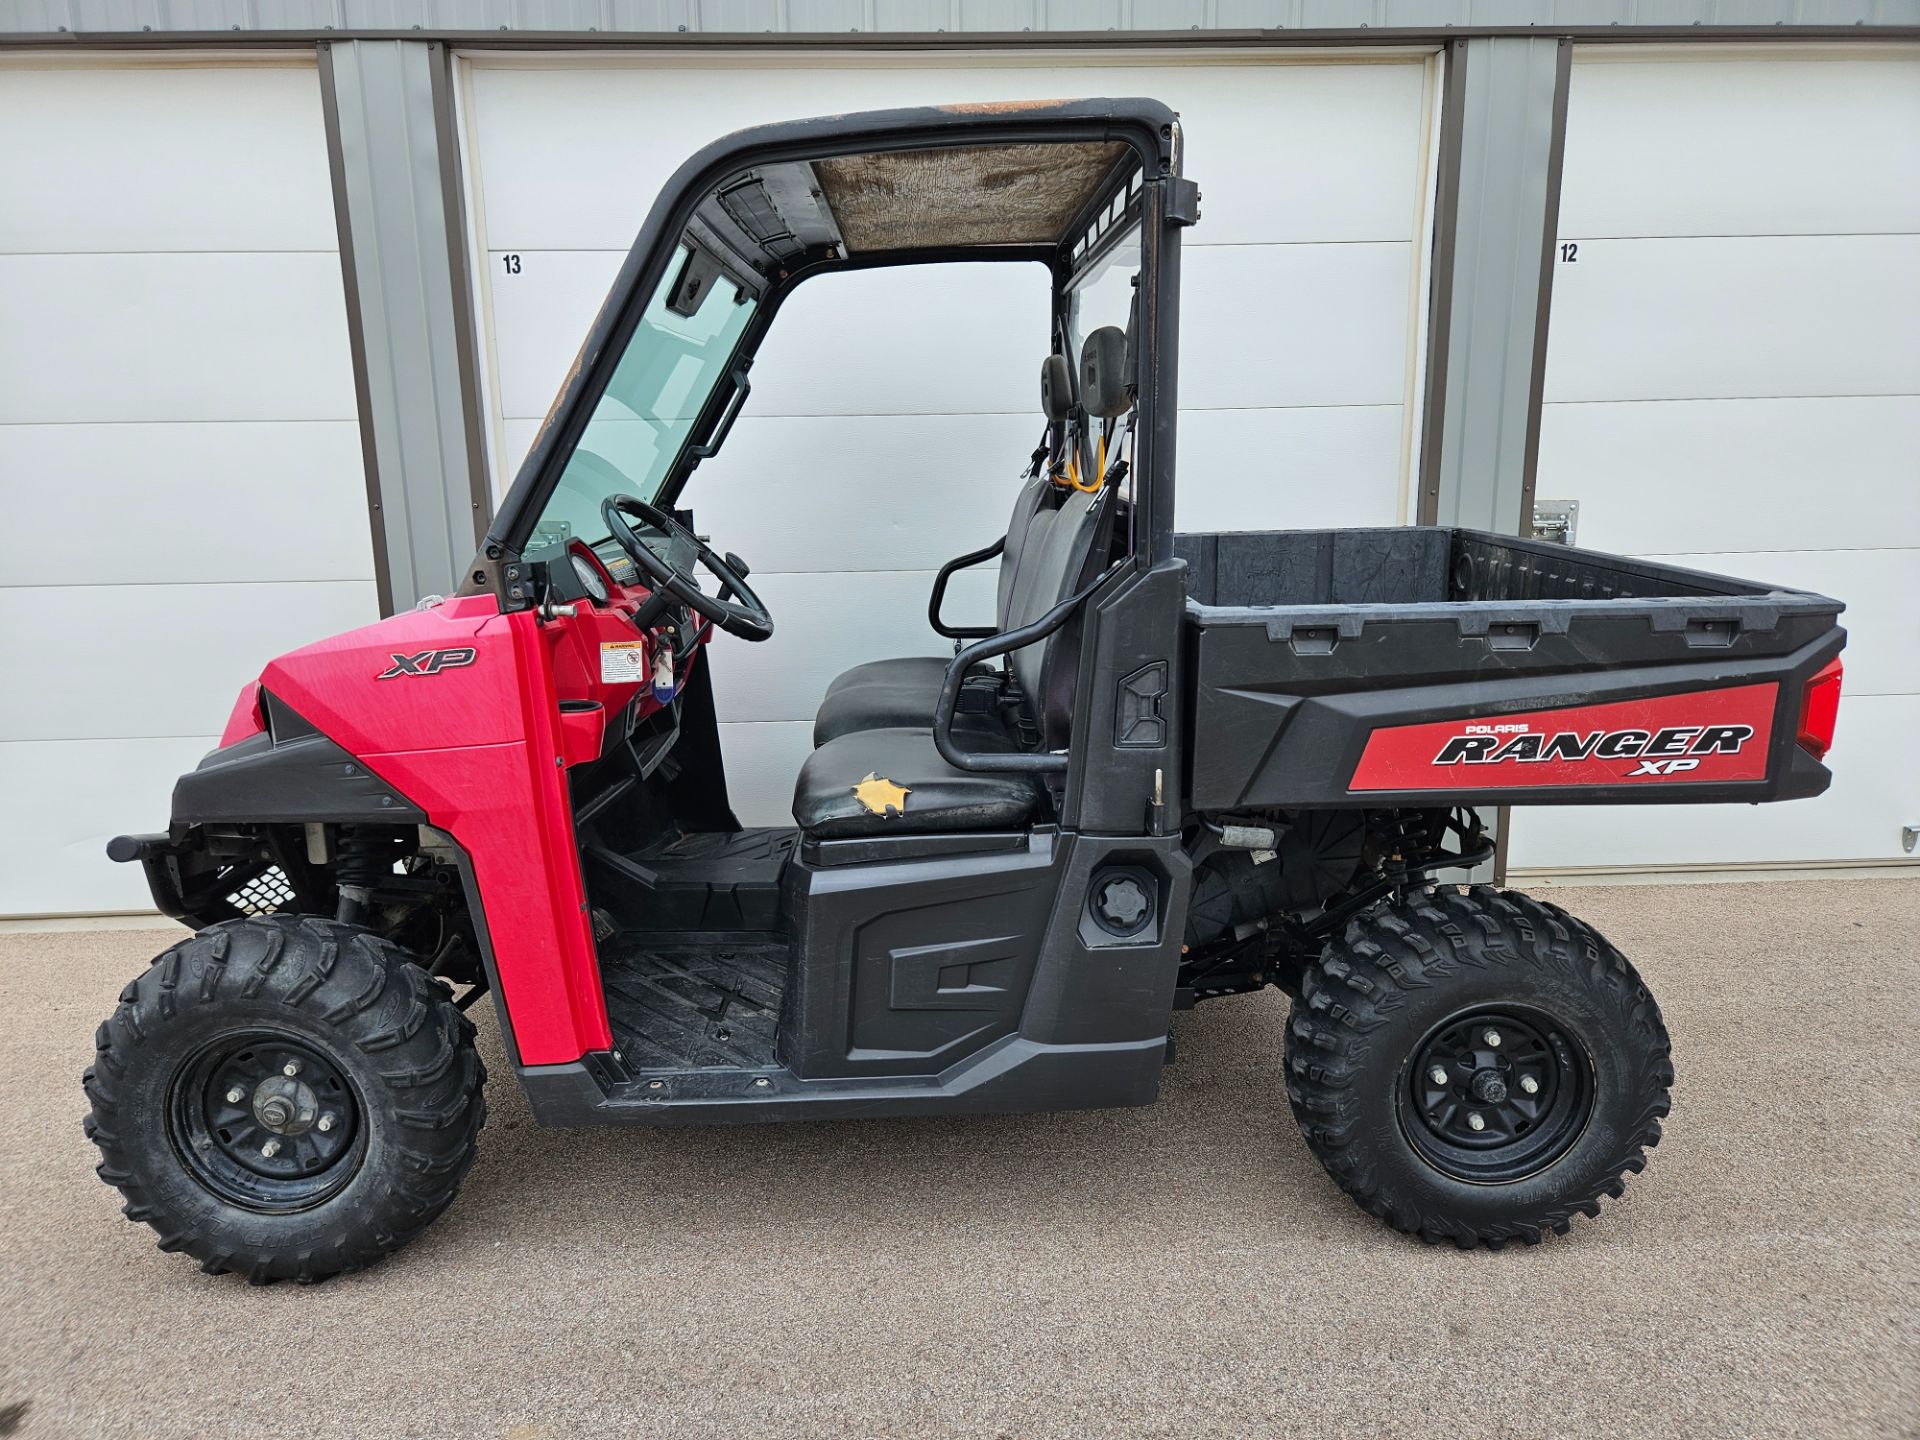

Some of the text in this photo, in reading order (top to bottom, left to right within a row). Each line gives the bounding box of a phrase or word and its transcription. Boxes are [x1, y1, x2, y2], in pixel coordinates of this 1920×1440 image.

[1560, 243, 1578, 263] 12
[503, 254, 521, 274] 13
[377, 647, 476, 679] XP
[1465, 723, 1529, 735] POLARIS
[1431, 724, 1754, 765] RANGER
[1624, 758, 1701, 777] XP
